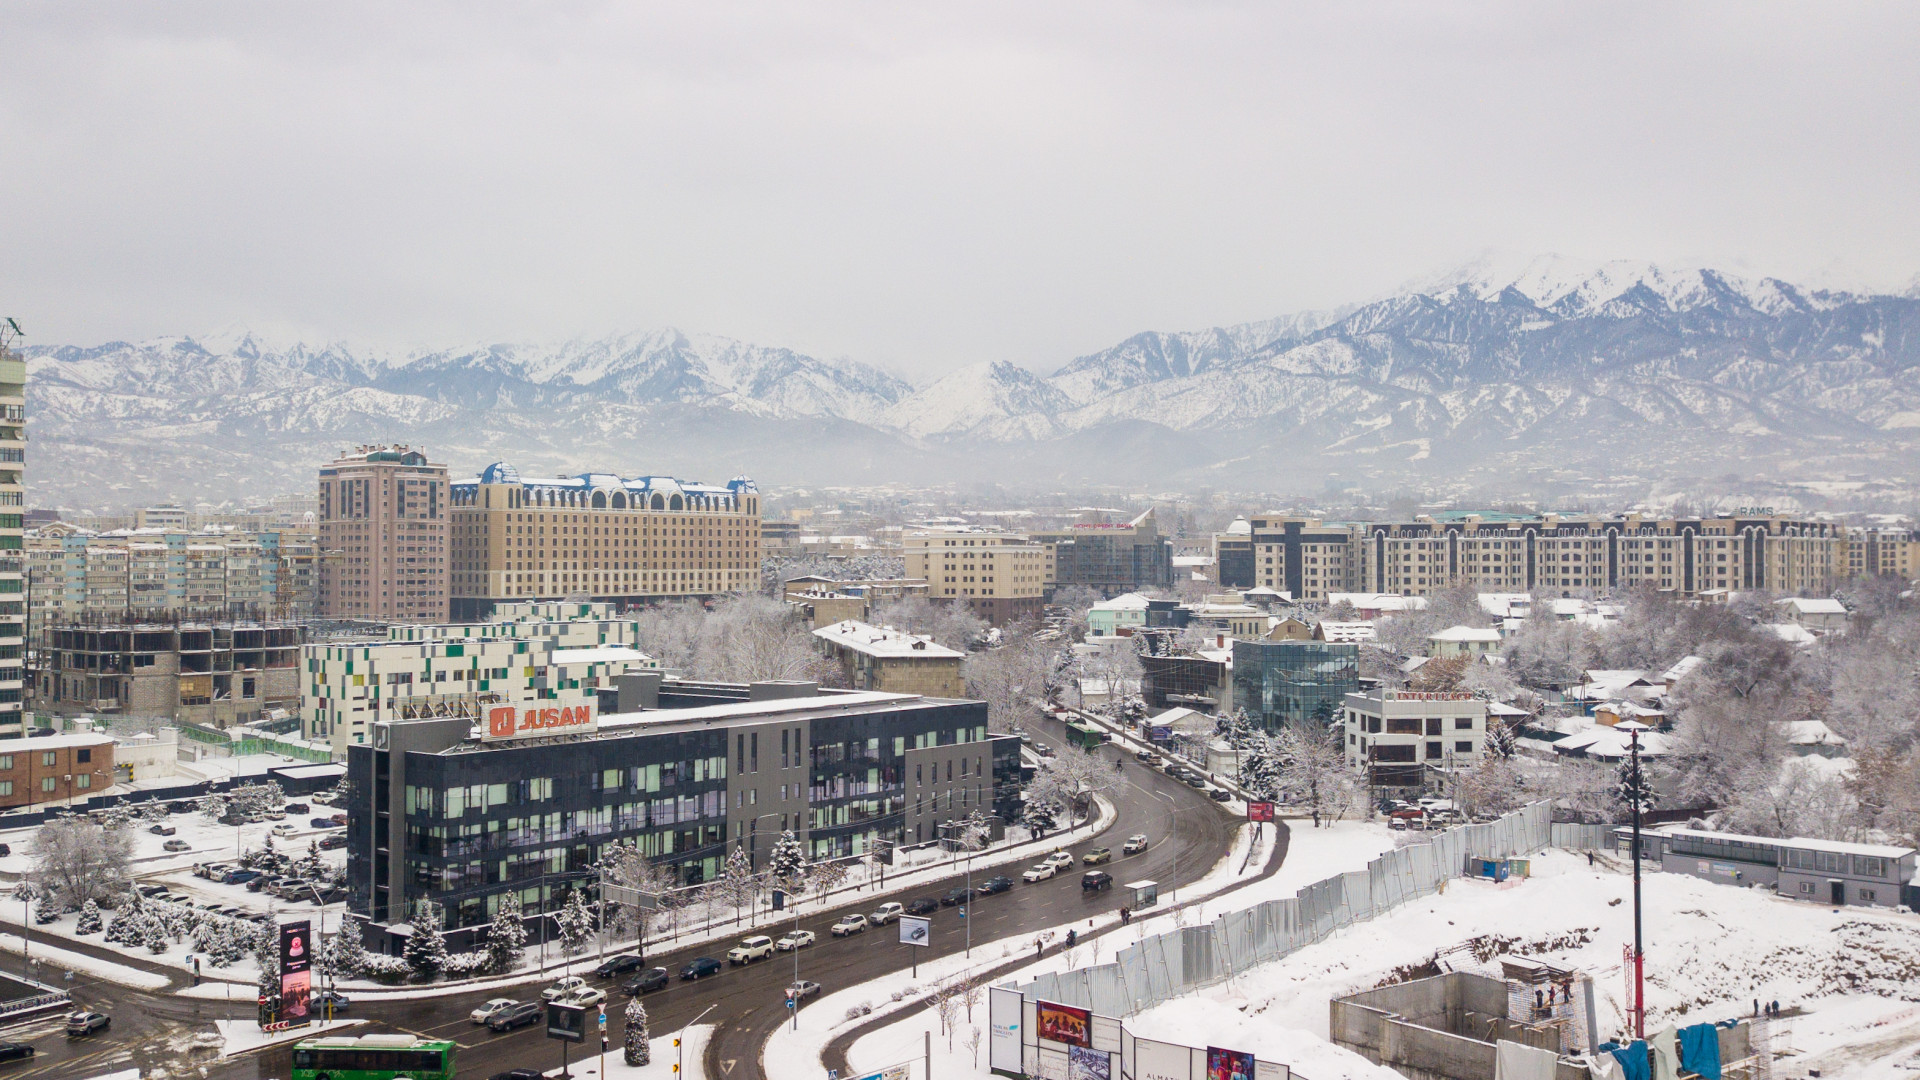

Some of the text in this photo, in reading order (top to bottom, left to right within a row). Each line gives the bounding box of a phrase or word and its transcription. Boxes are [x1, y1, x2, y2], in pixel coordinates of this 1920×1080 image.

[1740, 506, 1774, 516] RAMS
[1397, 692, 1472, 701] INTERTEACH
[518, 705, 590, 730] JUSAN
